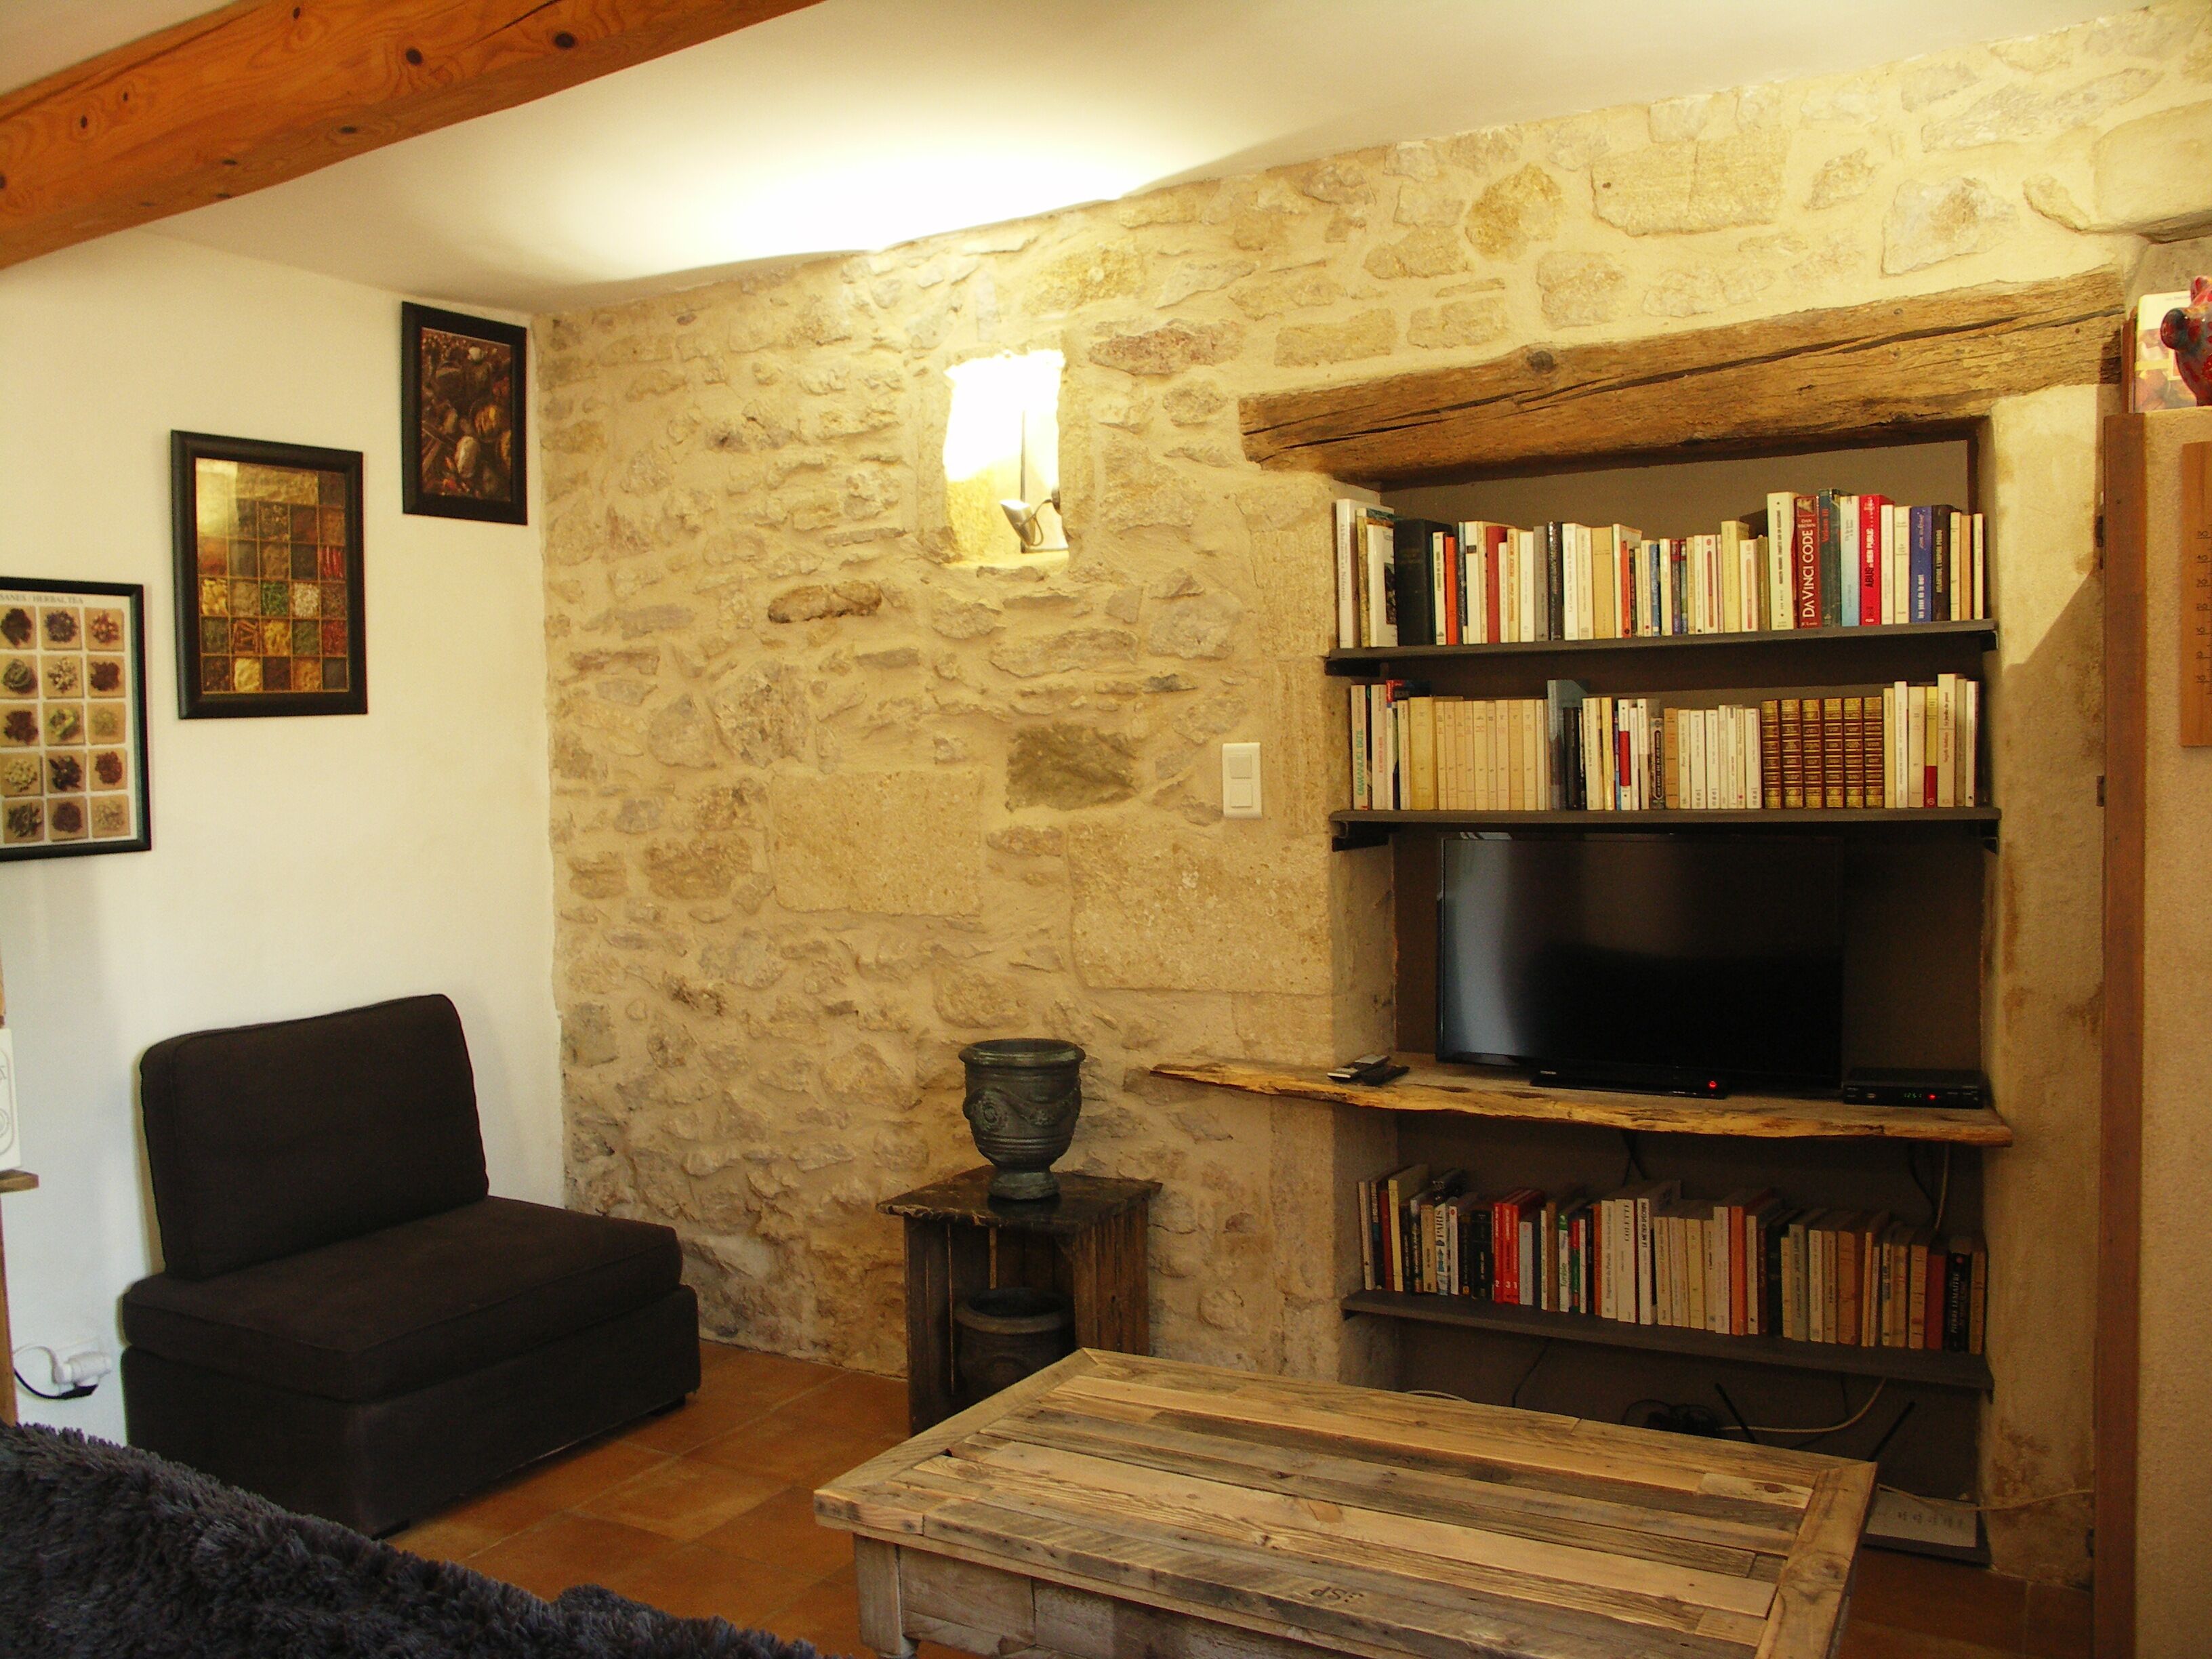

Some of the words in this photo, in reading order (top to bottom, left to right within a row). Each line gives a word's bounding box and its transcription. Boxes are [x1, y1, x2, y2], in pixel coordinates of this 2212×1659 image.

[1802, 529, 1814, 563] CODE
[1802, 565, 1815, 600] VINCI
[1802, 600, 1815, 618] DA
[1435, 1210, 1444, 1237] PARIS
